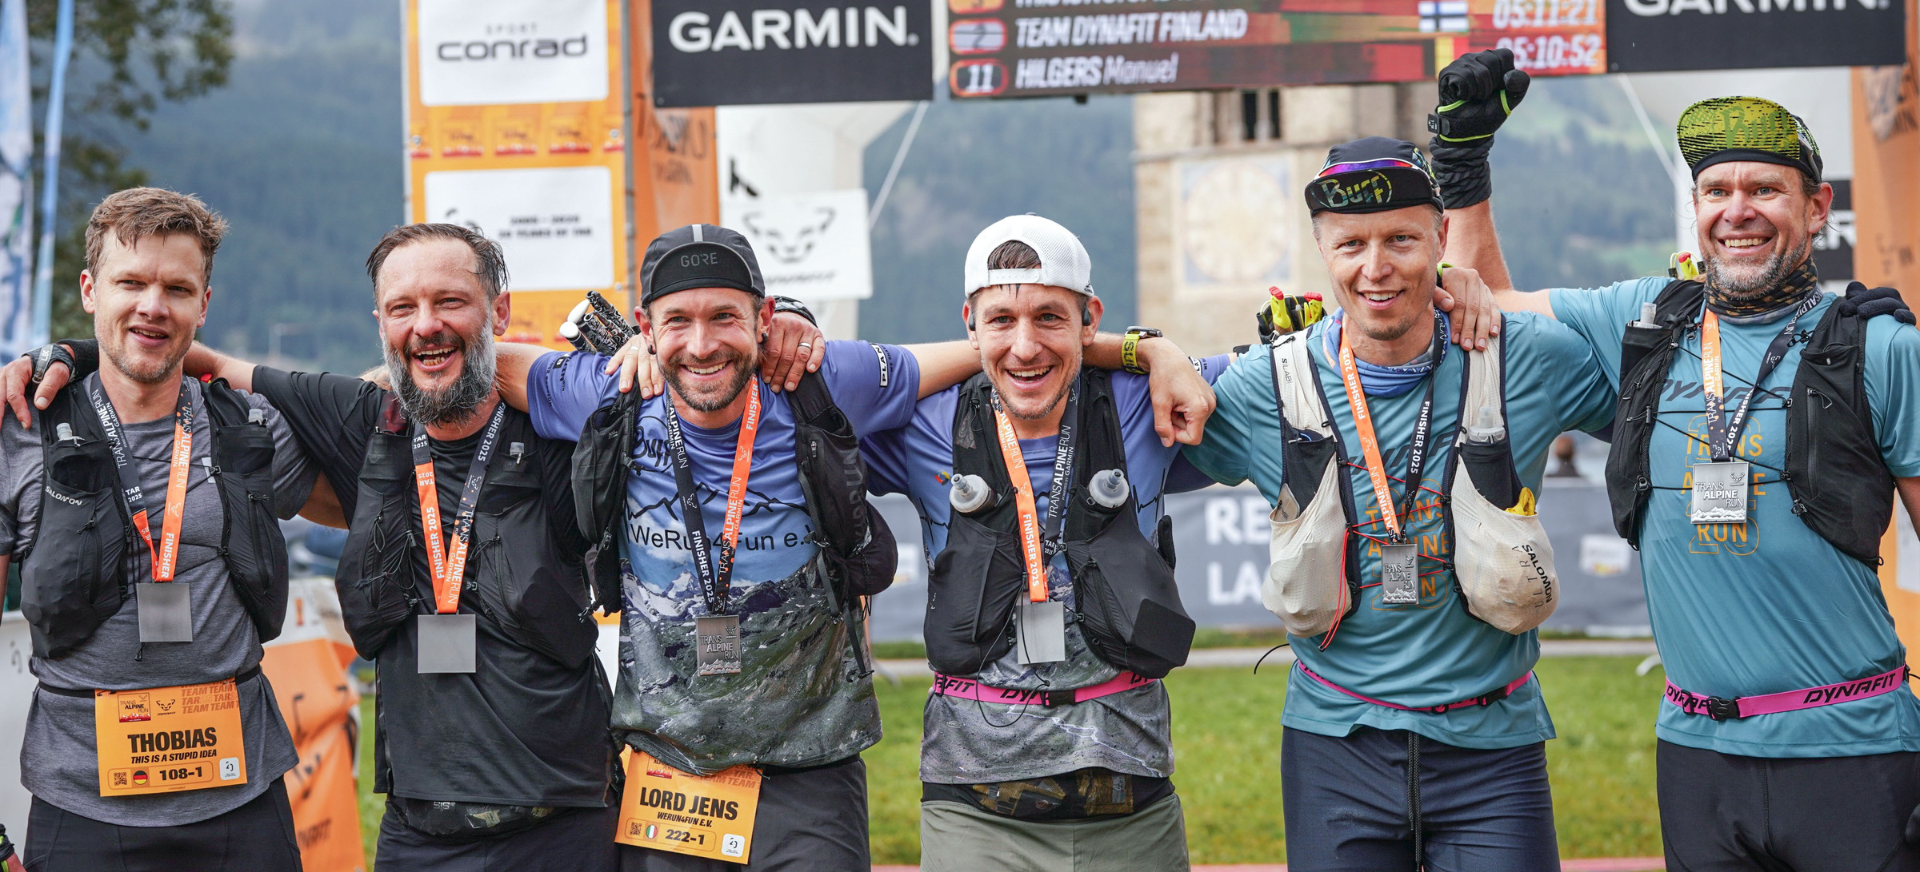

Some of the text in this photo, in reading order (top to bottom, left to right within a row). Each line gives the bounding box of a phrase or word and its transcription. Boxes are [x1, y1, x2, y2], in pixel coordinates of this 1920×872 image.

[1015, 17, 1072, 48] TEAM
[1071, 12, 1160, 46] DYNAFIT
[1157, 8, 1249, 43] FINLAND
[437, 34, 588, 61] conrad
[966, 63, 995, 93] 11
[1015, 55, 1103, 88] HILGERS
[1102, 52, 1180, 85] Manuel
[680, 252, 718, 268] GORE
[1342, 347, 1366, 421] FINISHER 2025
[745, 384, 758, 431] FINISHER
[413, 434, 427, 443] TAR
[478, 402, 506, 462] FINISHER 2025
[1410, 400, 1431, 475] FINISHER 2025
[172, 437, 180, 468] GARMIN
[1064, 446, 1074, 476] GARMIN
[1048, 424, 1072, 519] TRANSALPINERUN
[125, 485, 141, 497] TAR
[1695, 480, 1725, 493] TRANS
[1702, 489, 1738, 501] ALPINE
[733, 498, 743, 530] GARMIN
[1725, 498, 1745, 508] RUN
[718, 476, 742, 575] TRANSALPINERUN
[1696, 522, 1748, 543] RUN
[161, 532, 175, 579] FINISHER
[426, 506, 446, 580] FINISHER 2025
[1022, 513, 1040, 588] FINISHER 2025
[446, 552, 456, 583] GARMIN
[691, 529, 715, 604] FINISHER 2025
[1521, 544, 1553, 604] SALOMON
[699, 634, 722, 645] TRANS
[706, 643, 734, 653] ALPINE
[181, 686, 208, 697] TEAM
[209, 683, 233, 694] TEAM
[182, 693, 231, 706] TAR TAR
[1802, 672, 1897, 705] DYNAFIT
[182, 704, 209, 714] TEAM
[210, 701, 235, 712] TEAM
[127, 727, 218, 754] THOBIAS
[131, 748, 217, 765] THIS IS A STUPID IDEA
[159, 766, 203, 781] 108-1
[728, 777, 757, 789] TEAM
[734, 769, 754, 780] TAR
[639, 786, 739, 821] LORD JENS
[656, 811, 713, 828] WERUN4FUN E.V.
[664, 828, 706, 846] 222-1
